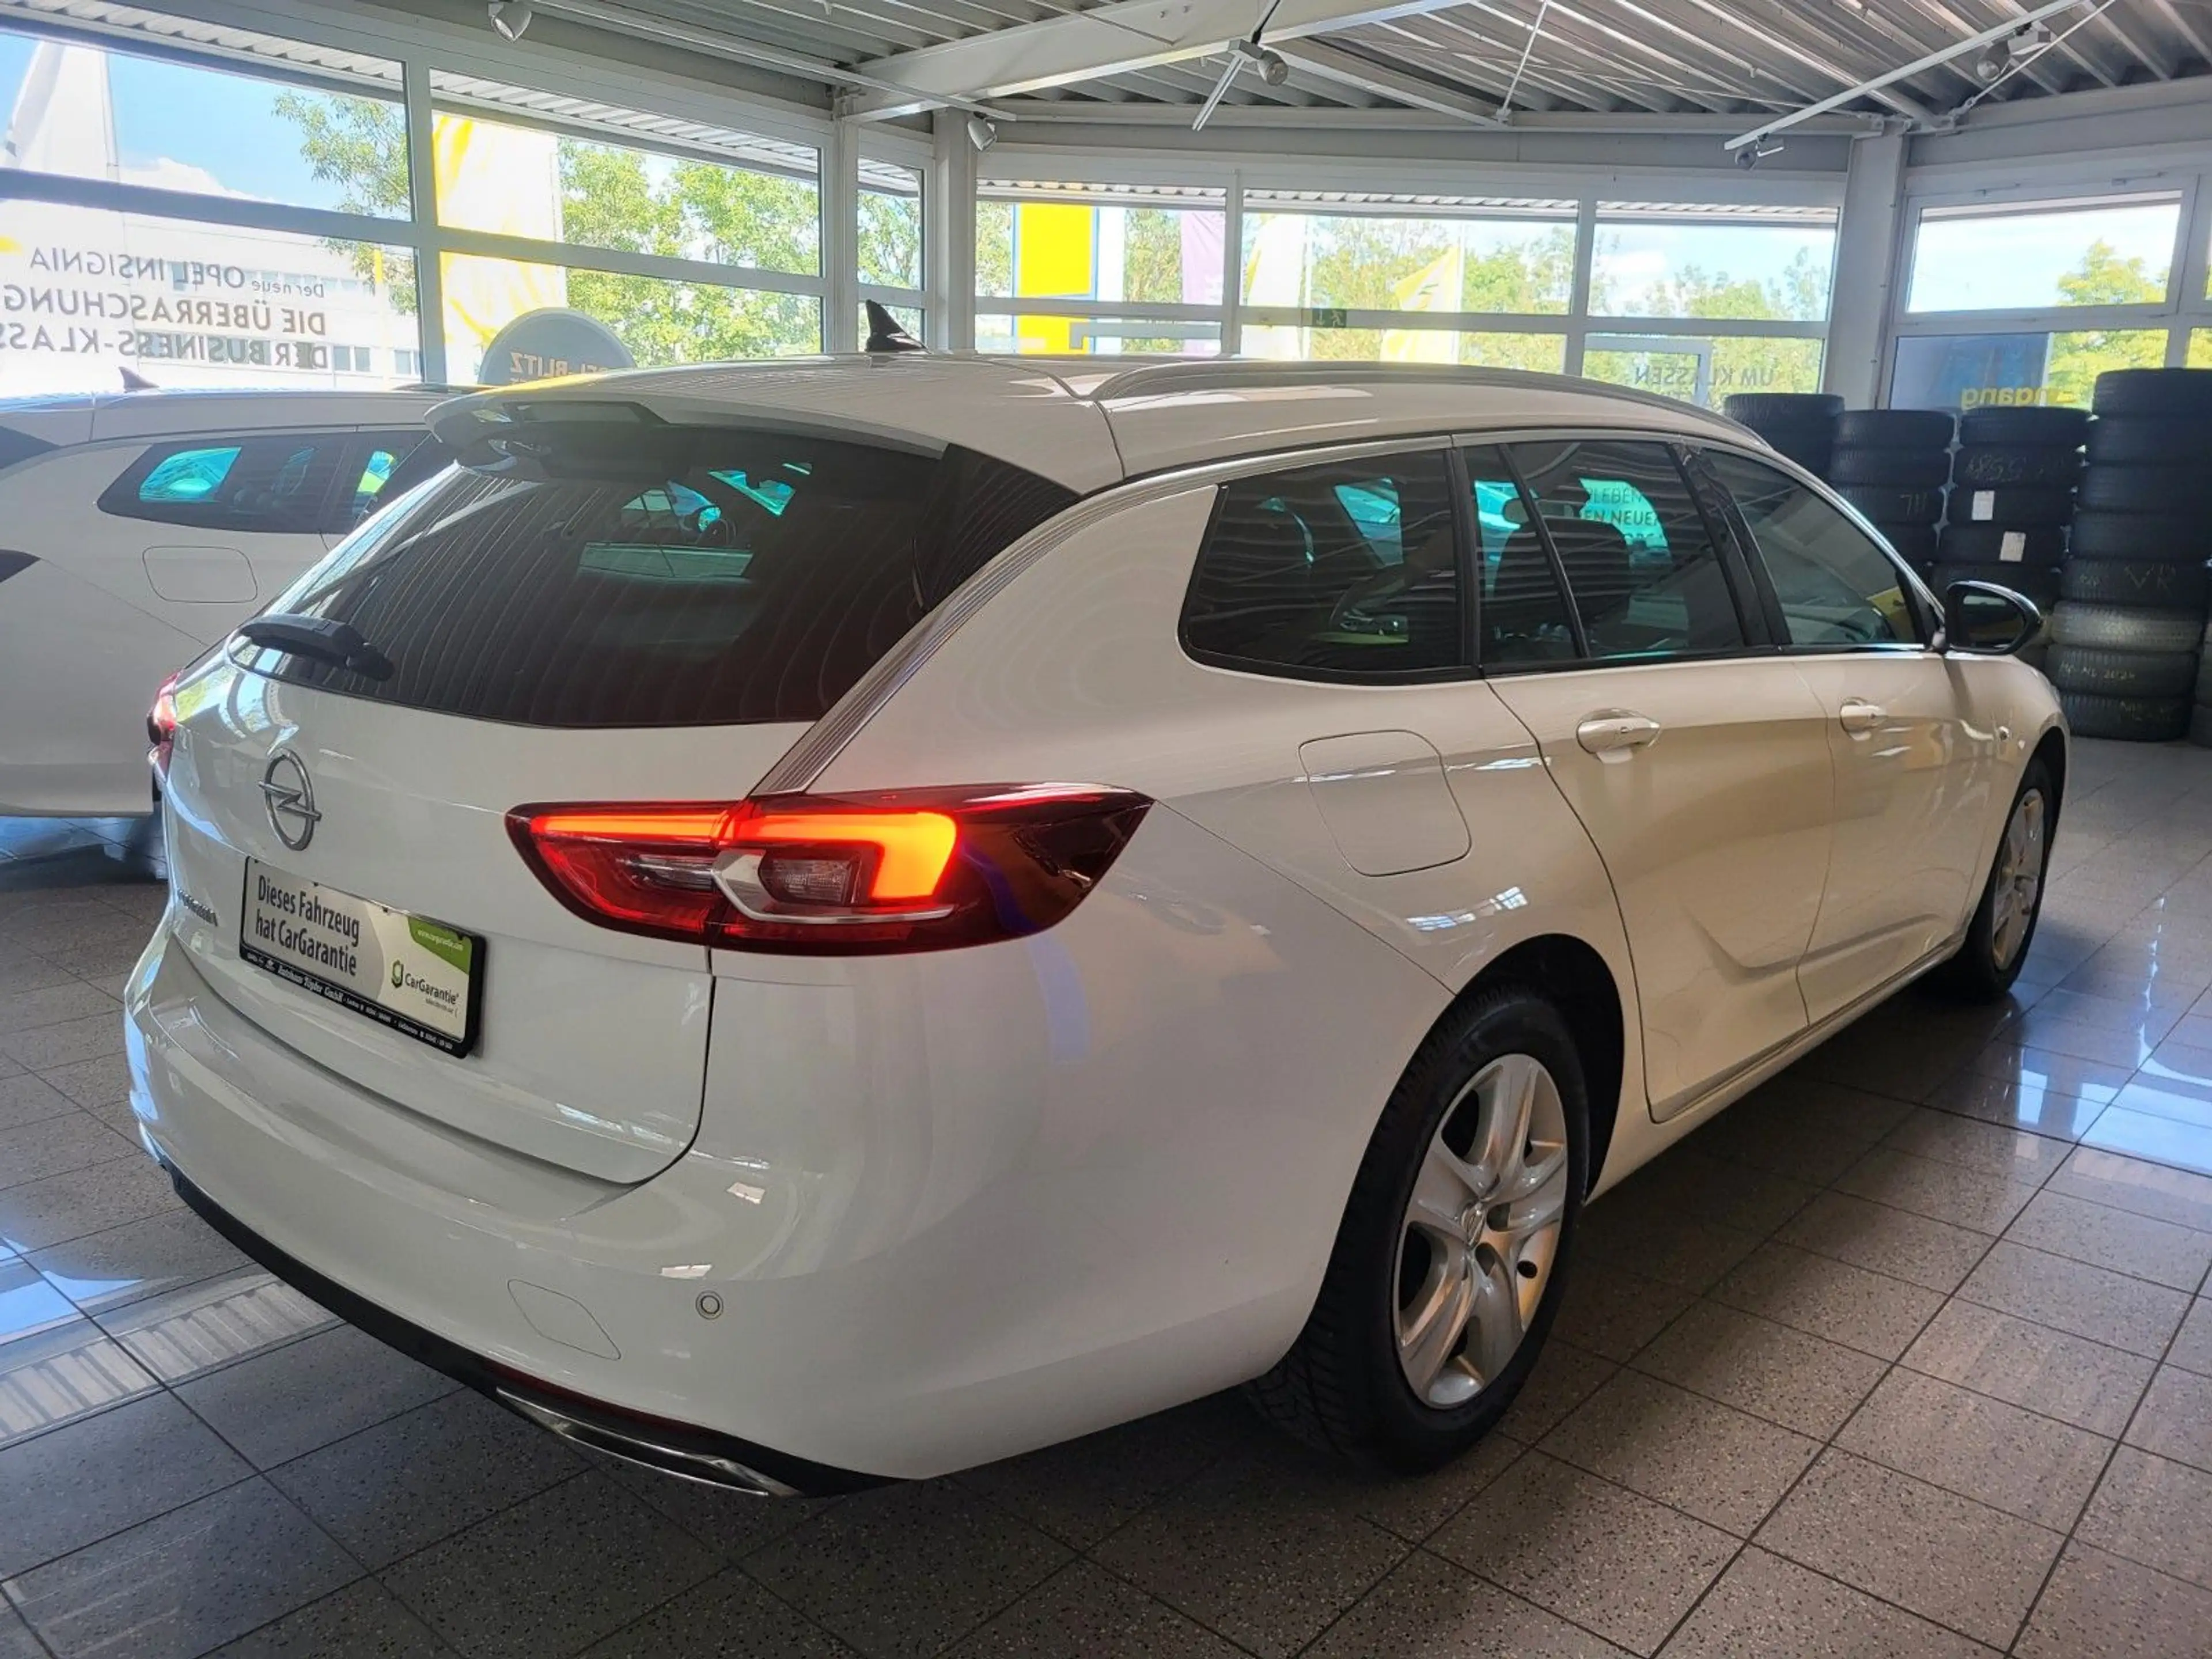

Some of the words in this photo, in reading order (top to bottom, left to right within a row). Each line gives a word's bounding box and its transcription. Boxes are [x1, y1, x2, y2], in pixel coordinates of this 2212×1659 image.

[256, 909, 276, 942] hat
[279, 923, 357, 976] CarGarantie
[258, 875, 296, 914] Dieses
[299, 891, 359, 947] Fahrzeug
